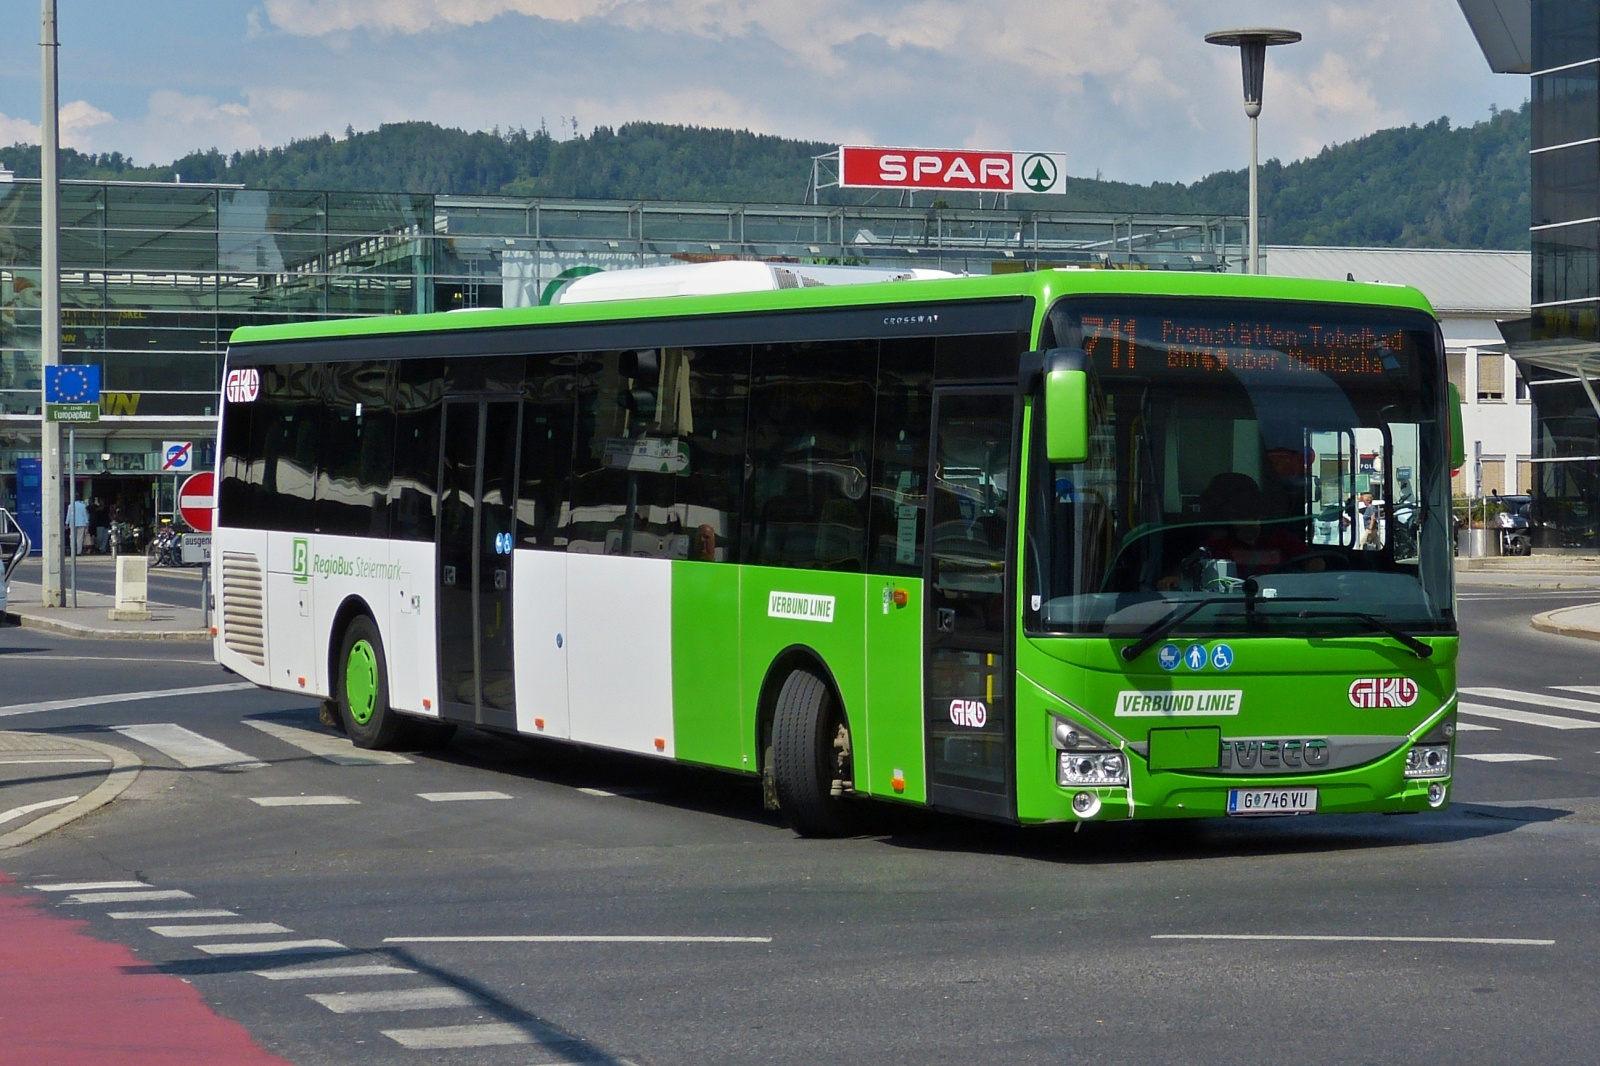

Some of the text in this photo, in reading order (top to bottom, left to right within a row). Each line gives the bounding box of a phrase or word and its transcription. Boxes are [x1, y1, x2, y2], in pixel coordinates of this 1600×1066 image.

[879, 154, 1010, 185] SPAR
[1082, 317, 1136, 369] 711
[1163, 319, 1403, 351] Premstätten-Tobelbad
[1232, 347, 1280, 371] über
[1288, 348, 1382, 374] Mantscha
[53, 410, 92, 420] Europaplatz
[203, 549, 212, 558] Ta
[313, 553, 403, 580] RegioBus Steiermark
[771, 595, 831, 617] VERBUND LINIE
[1123, 694, 1236, 712] VERBUND LINIE
[1221, 740, 1330, 768] IVECO
